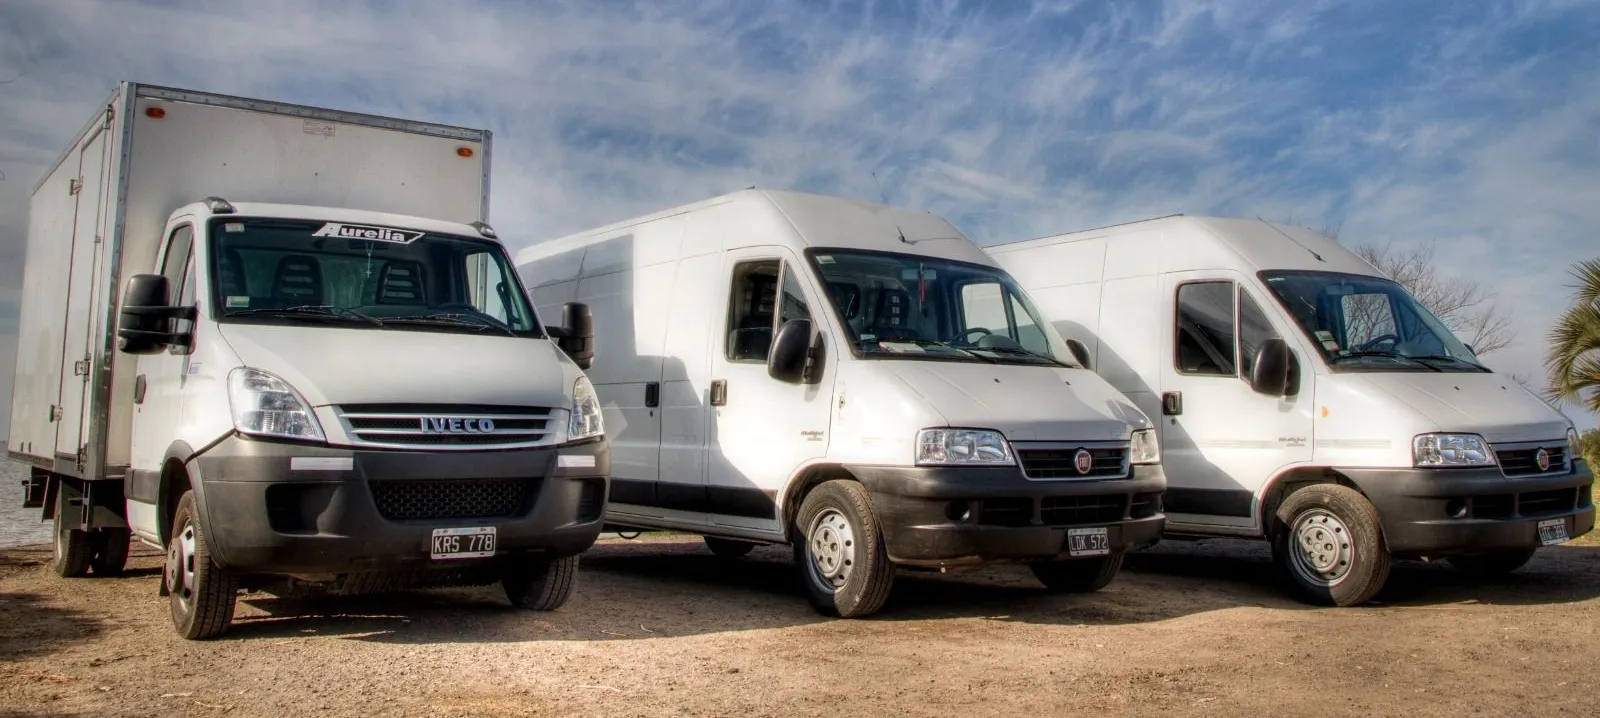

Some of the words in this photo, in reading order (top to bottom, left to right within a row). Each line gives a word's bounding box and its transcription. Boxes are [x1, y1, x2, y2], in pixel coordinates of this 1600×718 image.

[312, 222, 405, 242] Aurelia
[420, 416, 495, 433] IVECO
[434, 536, 460, 553] KRS
[468, 534, 493, 551] 778
[1070, 535, 1087, 550] LDK
[1090, 534, 1107, 549] 572
